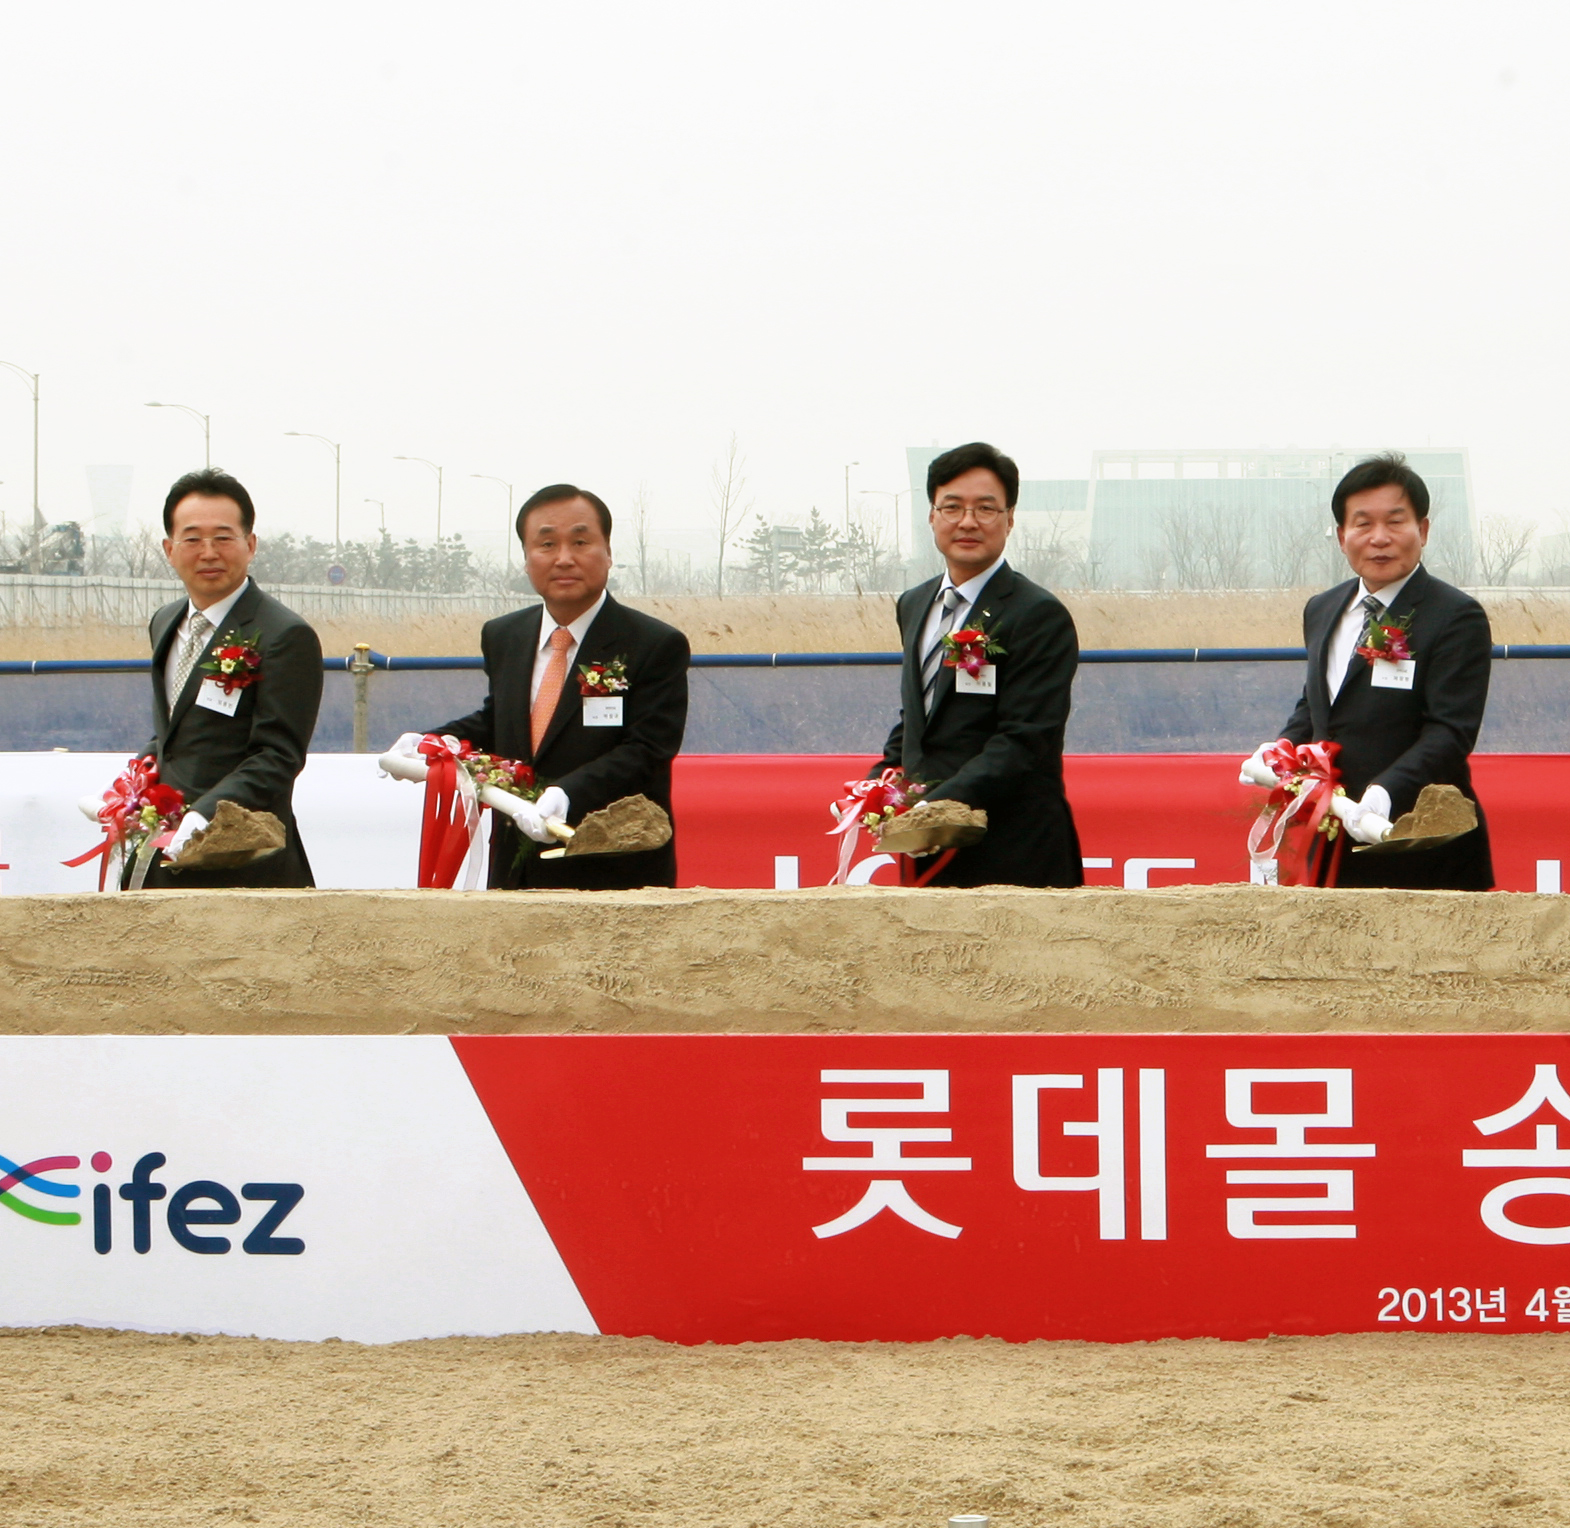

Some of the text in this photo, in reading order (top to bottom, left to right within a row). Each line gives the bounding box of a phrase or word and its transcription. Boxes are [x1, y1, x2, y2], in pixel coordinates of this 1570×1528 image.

[90, 1150, 307, 1256] ifez
[802, 1067, 1378, 1241] 롯데몰
[1377, 1286, 1507, 1324] 2013년
